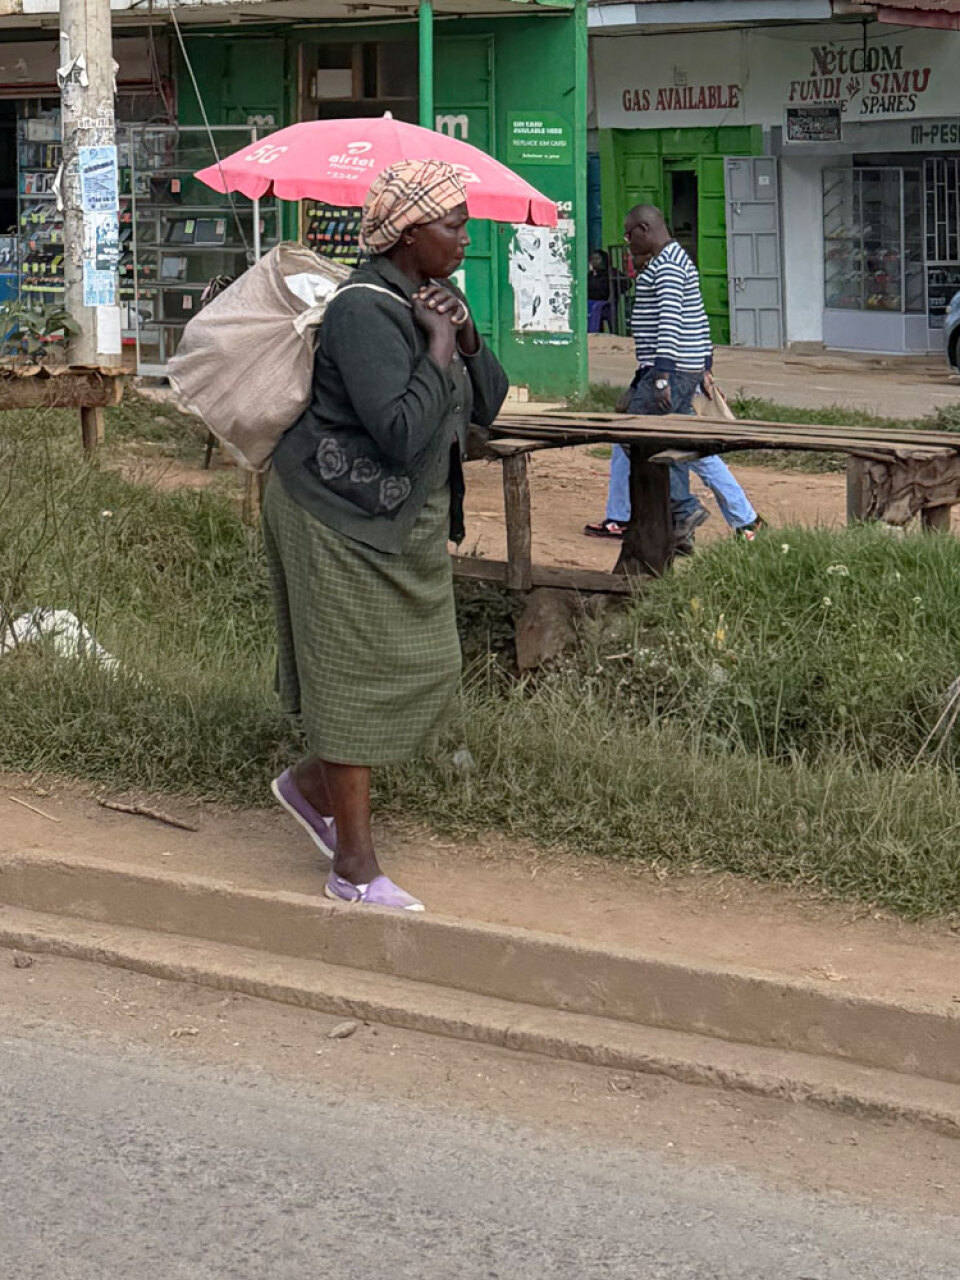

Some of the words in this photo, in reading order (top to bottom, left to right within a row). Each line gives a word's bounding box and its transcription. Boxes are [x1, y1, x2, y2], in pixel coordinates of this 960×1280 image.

[790, 78, 841, 101] FUNDI
[869, 68, 931, 94] SIMU
[623, 89, 650, 111] GAS
[656, 84, 742, 110] AVAILABLE
[860, 94, 918, 114] SPARES
[245, 144, 288, 164] 5G
[329, 154, 375, 168] airtel
